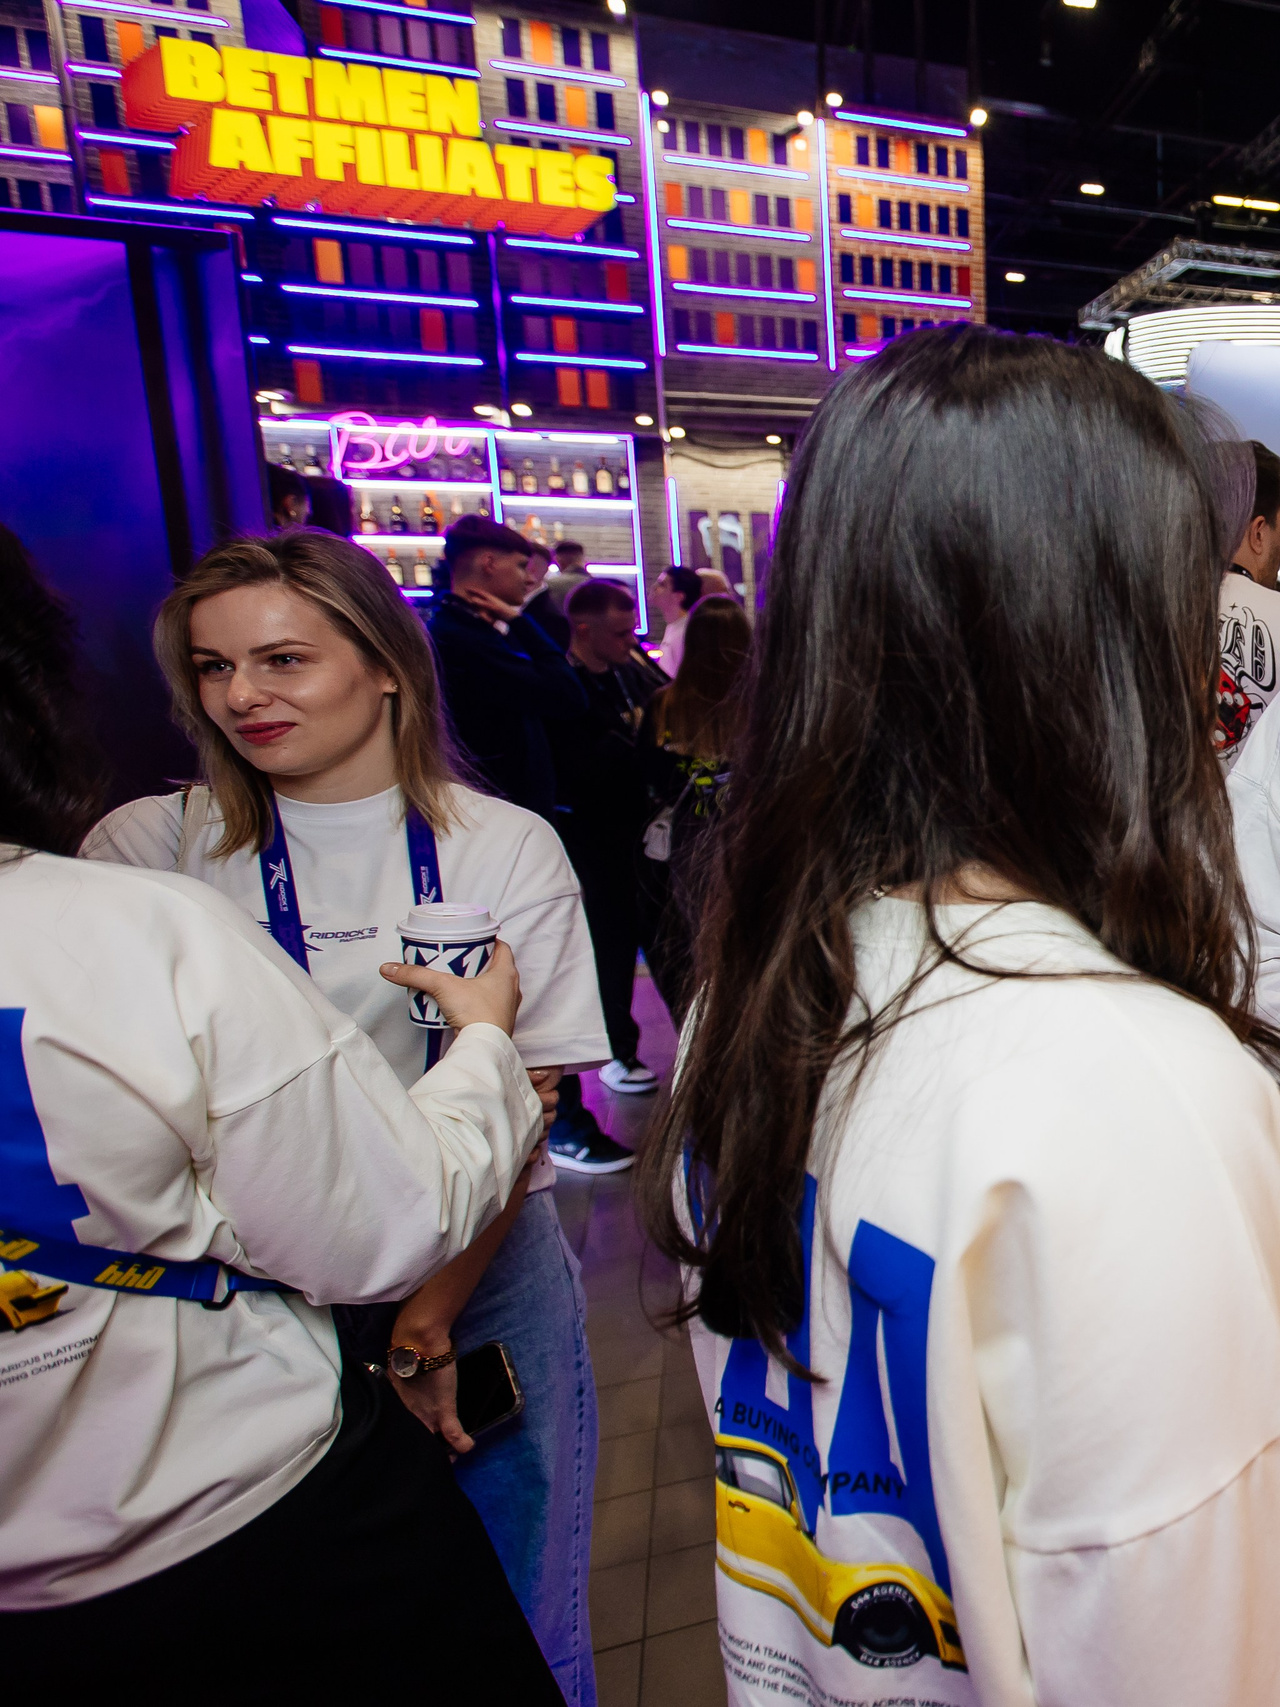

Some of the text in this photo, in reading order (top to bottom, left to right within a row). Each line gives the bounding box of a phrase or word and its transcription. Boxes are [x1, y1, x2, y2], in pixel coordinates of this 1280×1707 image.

[160, 37, 482, 138] BETMEN
[209, 108, 617, 213] AFFILIATES
[329, 411, 473, 473] Bar
[309, 927, 379, 939] RIDDICK'S
[0, 1334, 99, 1376] ARIOUS PLATFORM
[31, 1347, 94, 1376] COMPANIE
[731, 1402, 800, 1454] BUYING
[803, 1444, 904, 1499] CPANY
[747, 1658, 766, 1672] AND
[763, 1646, 787, 1662] TEAM
[733, 1668, 760, 1686] REACH
[762, 1679, 780, 1693] THE
